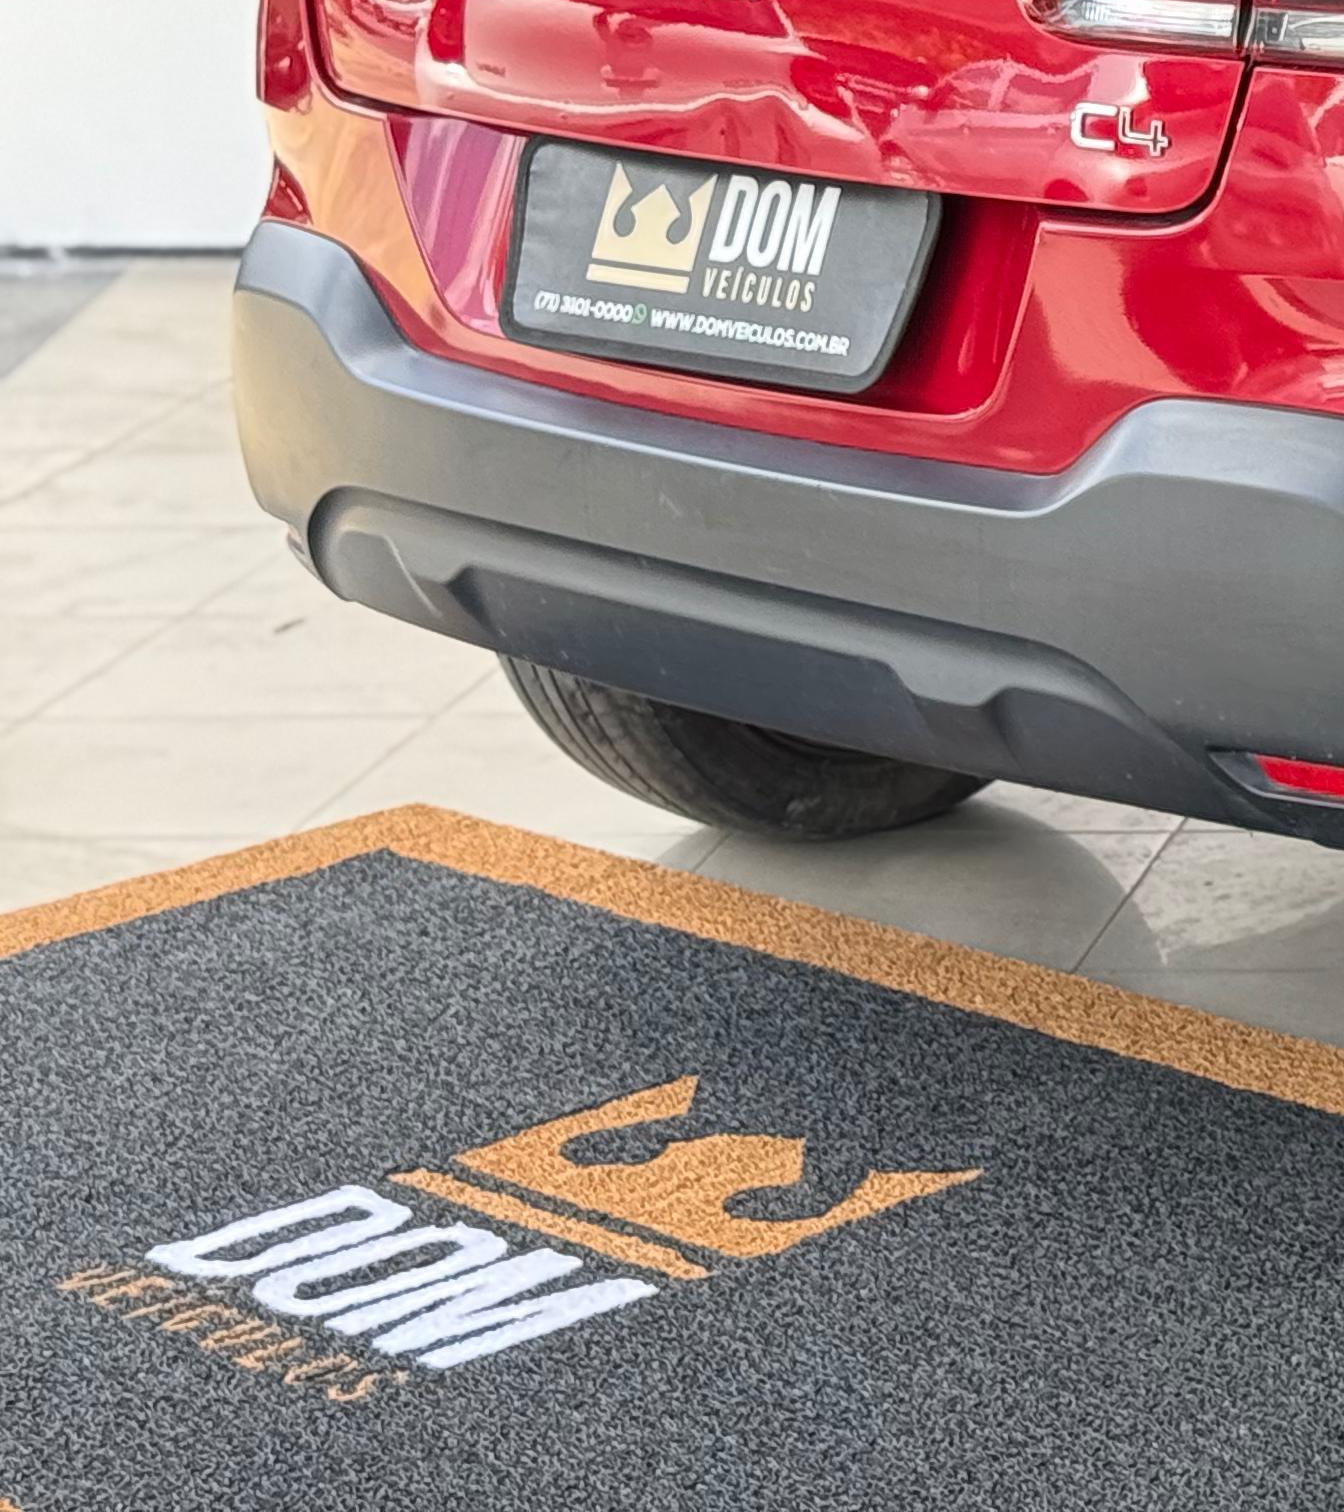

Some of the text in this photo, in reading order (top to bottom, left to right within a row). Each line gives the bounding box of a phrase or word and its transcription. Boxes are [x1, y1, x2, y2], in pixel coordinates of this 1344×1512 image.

[1070, 101, 1169, 157] C4
[708, 174, 842, 276] DOM
[145, 1184, 659, 1369] DOM
